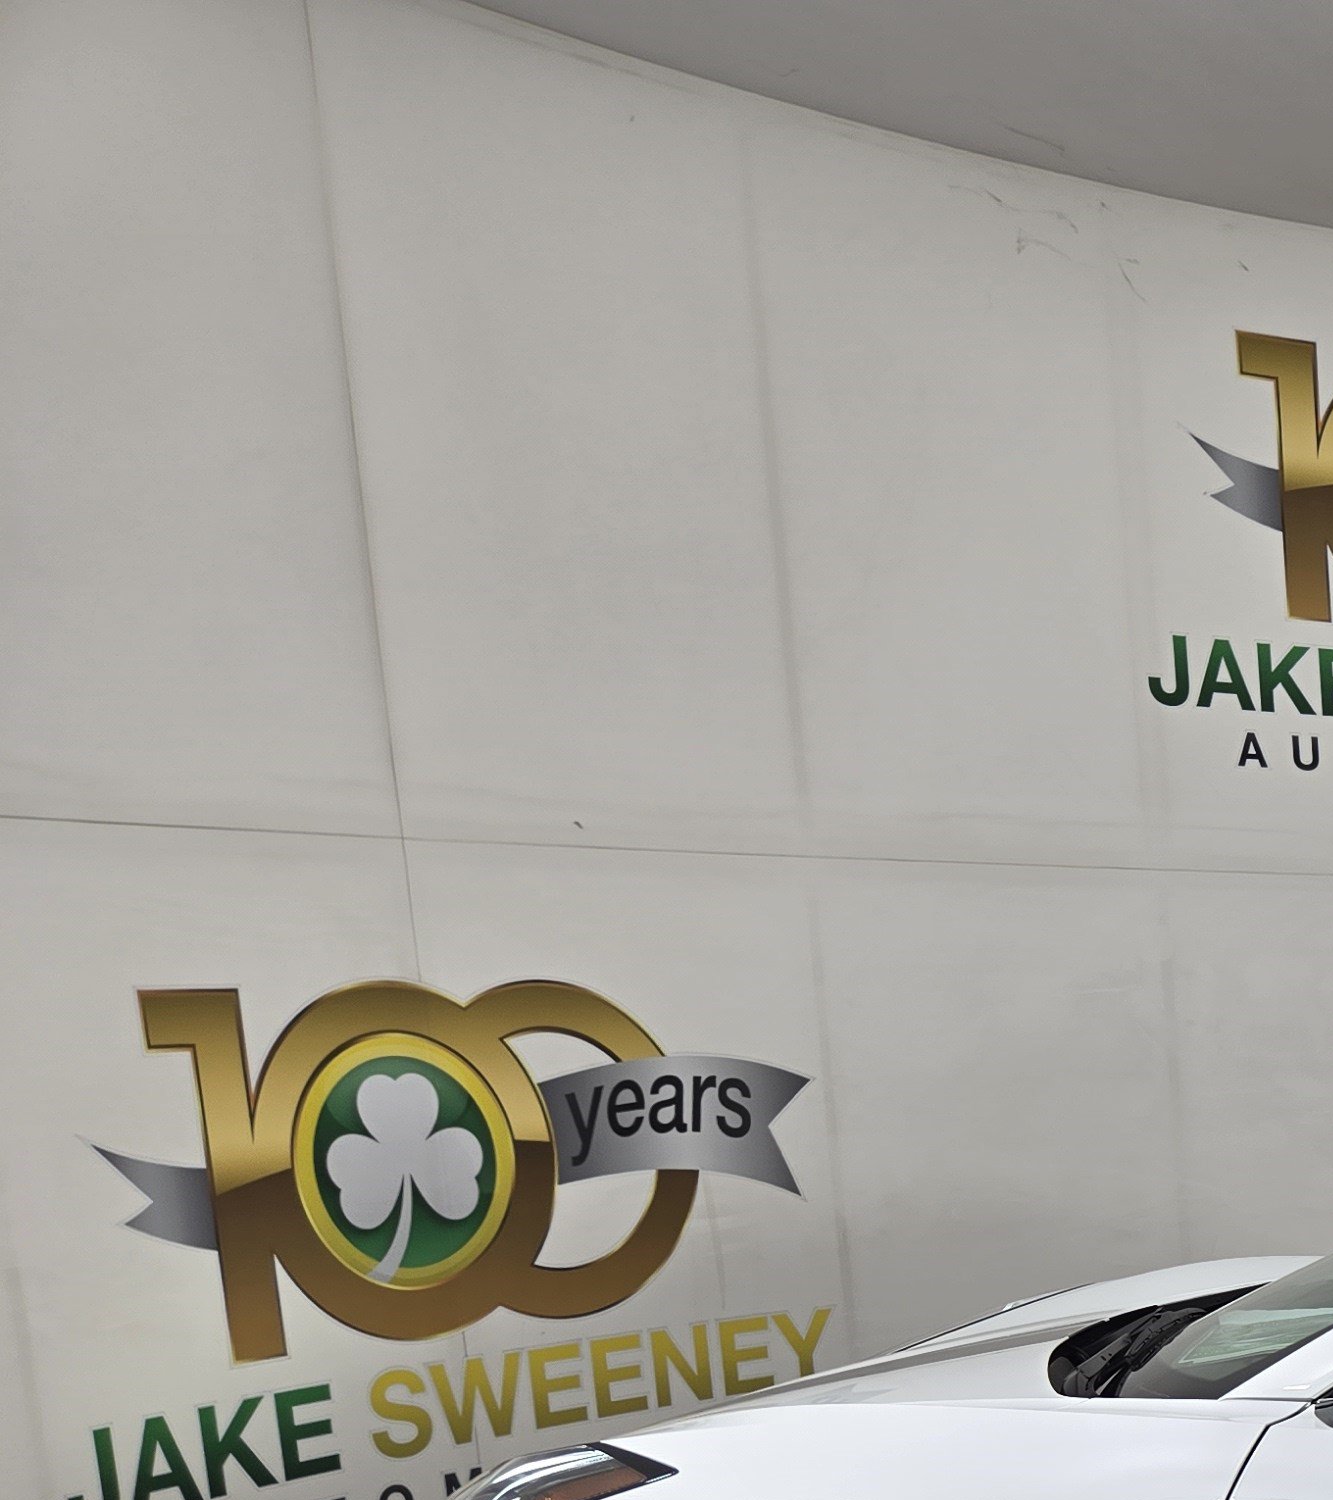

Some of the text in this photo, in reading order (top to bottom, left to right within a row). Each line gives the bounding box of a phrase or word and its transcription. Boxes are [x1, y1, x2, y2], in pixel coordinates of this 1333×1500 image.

[136, 980, 752, 1363] 100 years
[369, 1308, 833, 1459] SWEENEY
